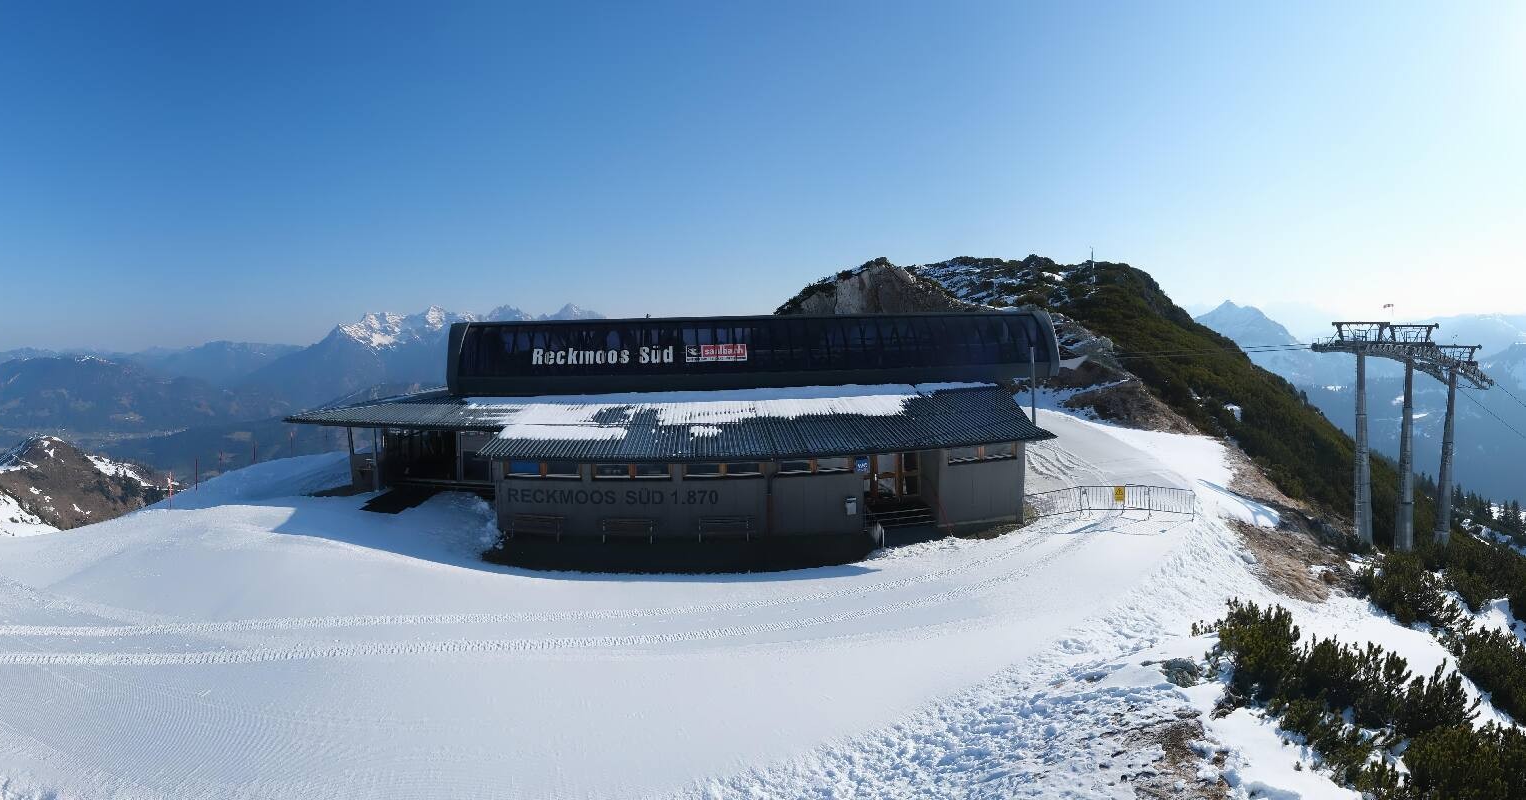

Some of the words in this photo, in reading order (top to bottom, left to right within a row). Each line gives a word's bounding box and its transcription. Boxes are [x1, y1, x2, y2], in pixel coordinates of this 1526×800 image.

[532, 347, 630, 365] Reckmoos
[639, 345, 674, 364] Süd
[507, 488, 616, 504] RECKMOOS
[625, 488, 664, 505] SÜD
[670, 490, 719, 504] 1.870
